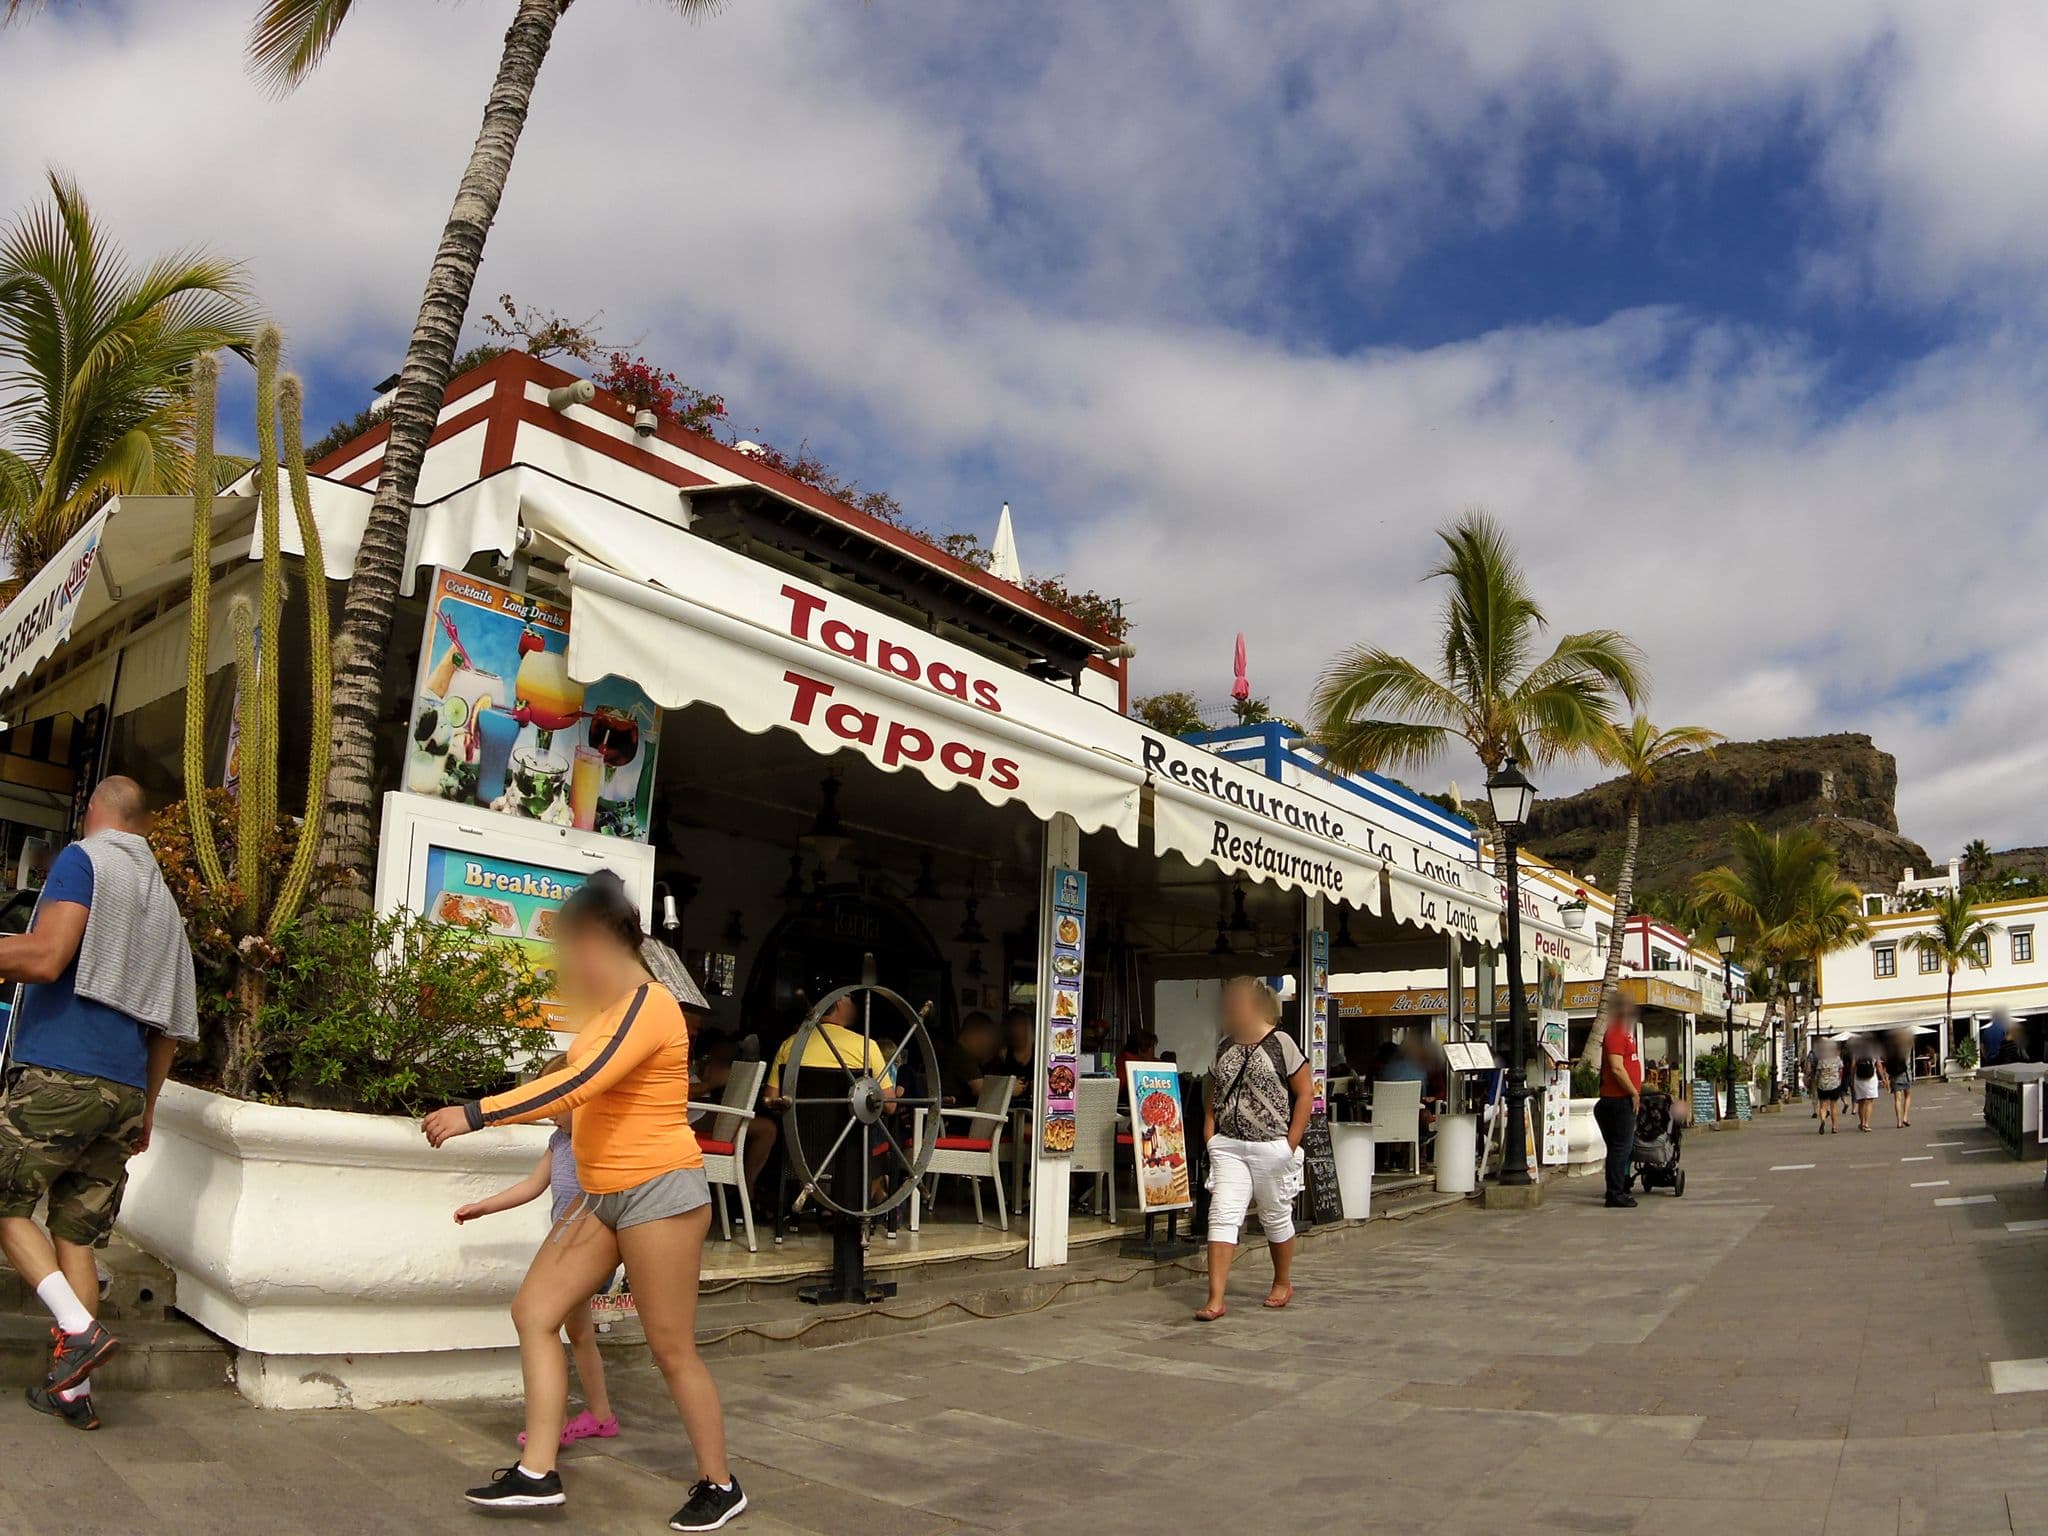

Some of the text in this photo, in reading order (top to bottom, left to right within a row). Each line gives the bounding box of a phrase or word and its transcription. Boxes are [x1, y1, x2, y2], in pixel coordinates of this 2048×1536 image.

[10, 584, 62, 664] CREAM
[445, 578, 565, 627] Cocktails Long Drinks
[780, 583, 1002, 713] Tapas
[783, 670, 1020, 790] Tapas
[1141, 735, 1461, 888] Restaurante La Lonja
[464, 862, 580, 901] Breakfas
[1210, 820, 1478, 934] Restaurante La Lonja
[1500, 884, 1541, 919] Pella
[1535, 932, 1571, 960] Paella
[1142, 1075, 1172, 1089] Cakes
[591, 1293, 634, 1310] KE AW
